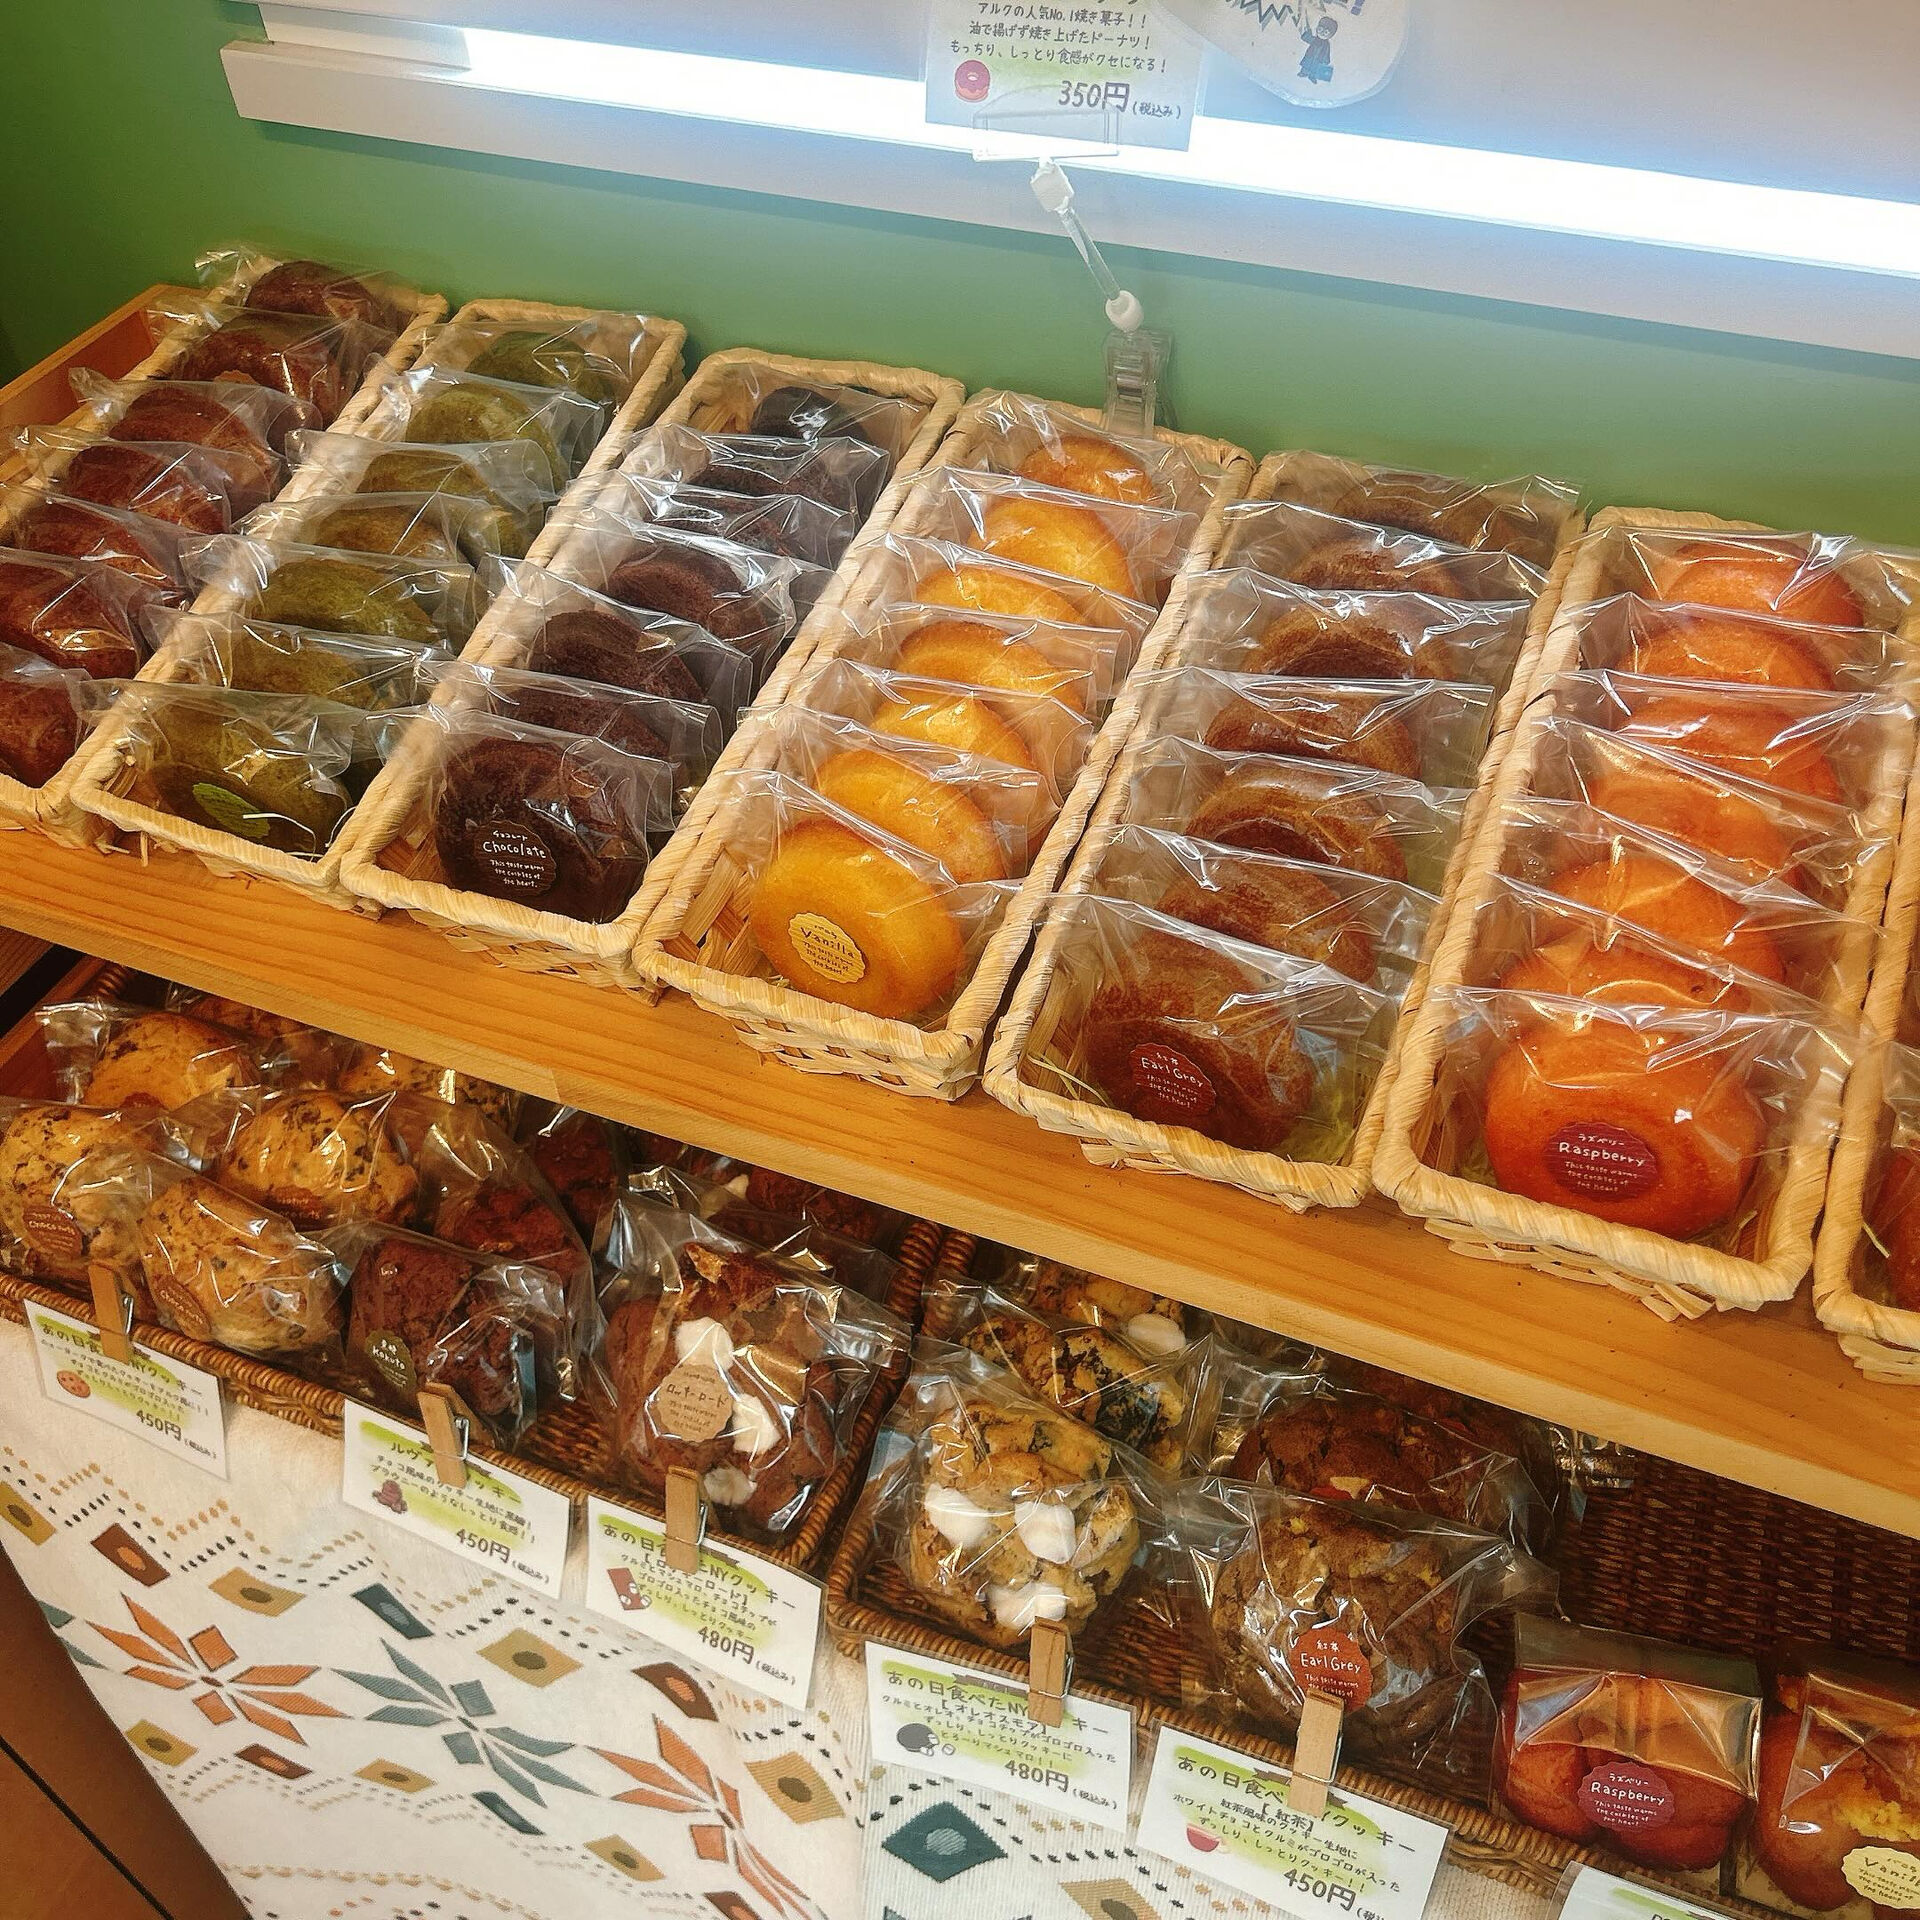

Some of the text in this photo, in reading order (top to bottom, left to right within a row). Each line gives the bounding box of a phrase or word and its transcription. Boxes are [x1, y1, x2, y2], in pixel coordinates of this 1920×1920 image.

[969, 21, 1149, 49] 油で揚げず焼き上げたドーナツ！
[951, 40, 1166, 73] もっちり、しっとり食感がクセになる！
[1058, 80, 1130, 112] 350円
[483, 841, 546, 859] Chocolate
[800, 926, 855, 959] Vanilla
[1141, 1056, 1204, 1088] Earl Grey
[1559, 1142, 1646, 1167] Raspberry
[136, 1409, 182, 1442] 450円
[456, 1528, 511, 1564] 450円
[697, 1625, 755, 1664] 480円
[1301, 1653, 1360, 1674] Earl Grey
[887, 1671, 1108, 1734] あの日食べたNYキー
[1004, 1760, 1069, 1793] 480円
[1609, 1773, 1649, 1786] ラズベリー
[1177, 1755, 1416, 1854] あの日食べクッキー
[1591, 1781, 1665, 1806] Raspberry
[1283, 1868, 1357, 1912] 450円
